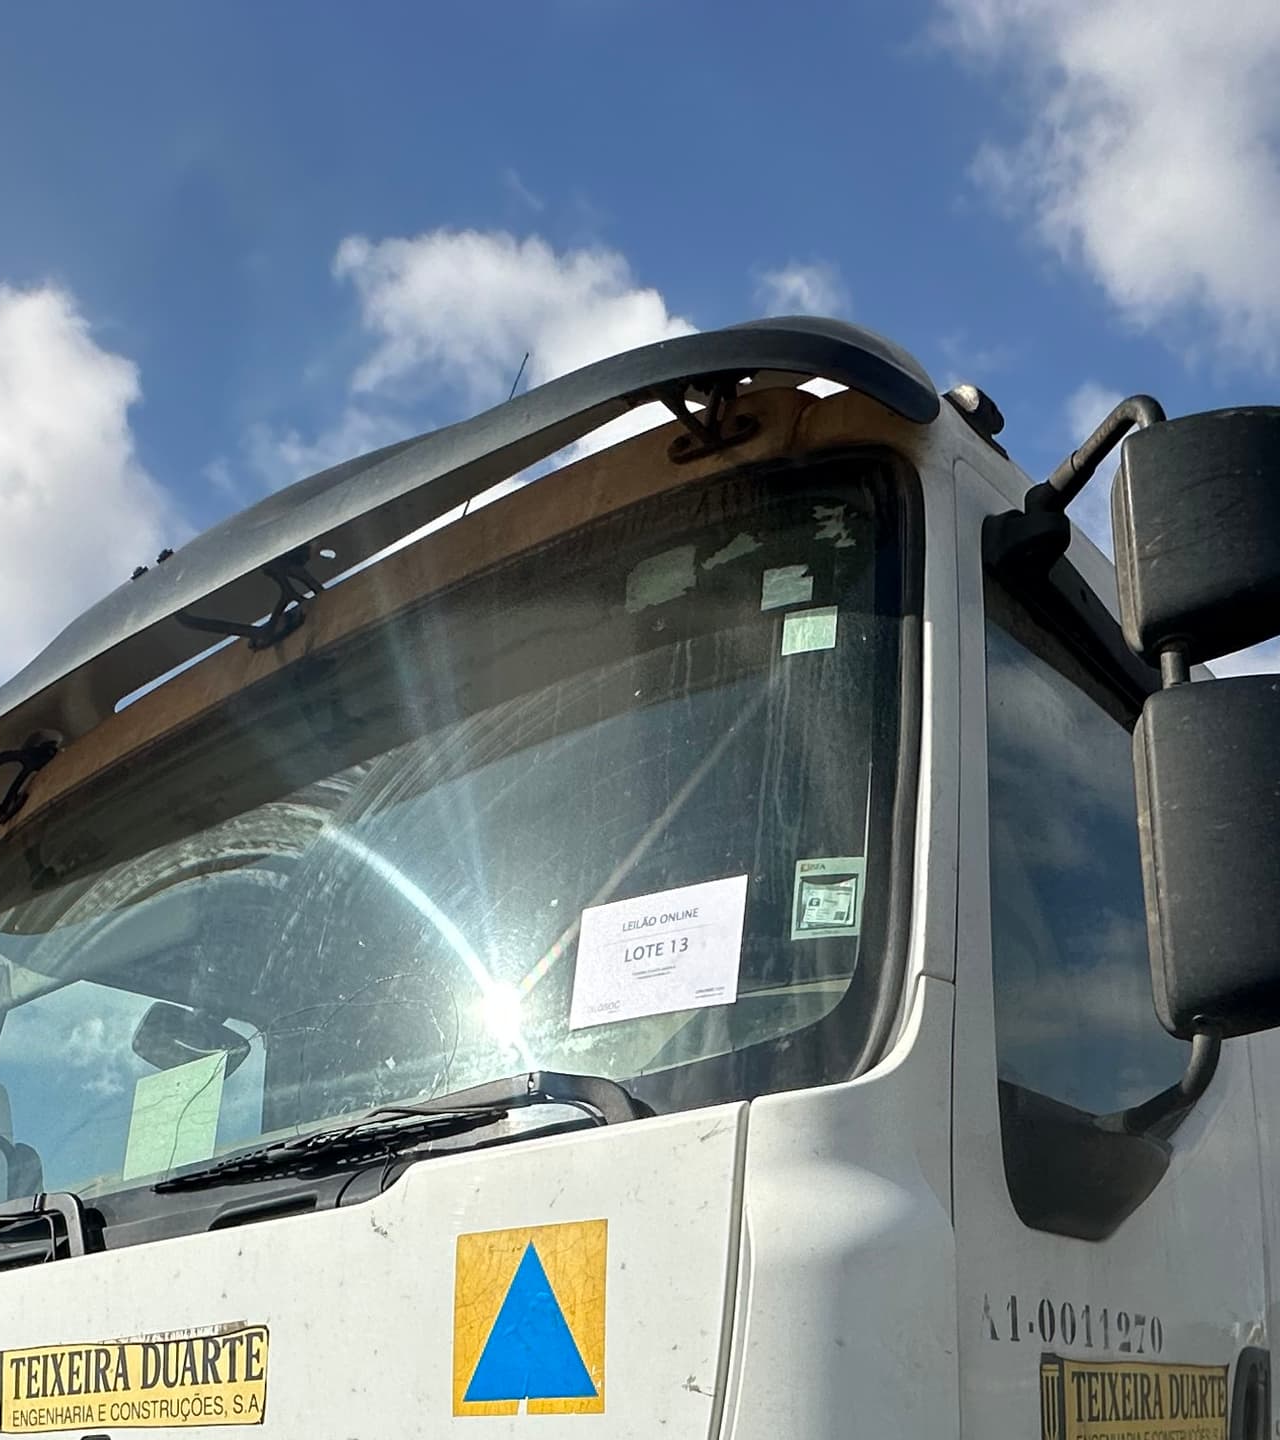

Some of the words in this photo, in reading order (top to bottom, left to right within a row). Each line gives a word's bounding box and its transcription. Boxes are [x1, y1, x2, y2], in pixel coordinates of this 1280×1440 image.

[622, 914, 657, 932] LEILÃO
[659, 907, 699, 924] ONLINE
[624, 942, 664, 963] LOTE
[671, 937, 689, 953] 13
[10, 1348, 131, 1400] TEIXEIRA
[141, 1332, 264, 1389] DUARTE
[12, 1404, 94, 1427] ENGENHARIA
[98, 1404, 107, 1421] E
[110, 1393, 228, 1422] CONSTRUÇÕES,
[1072, 1371, 1163, 1422] TEIXEIRA
[1169, 1374, 1226, 1420] DUARTE
